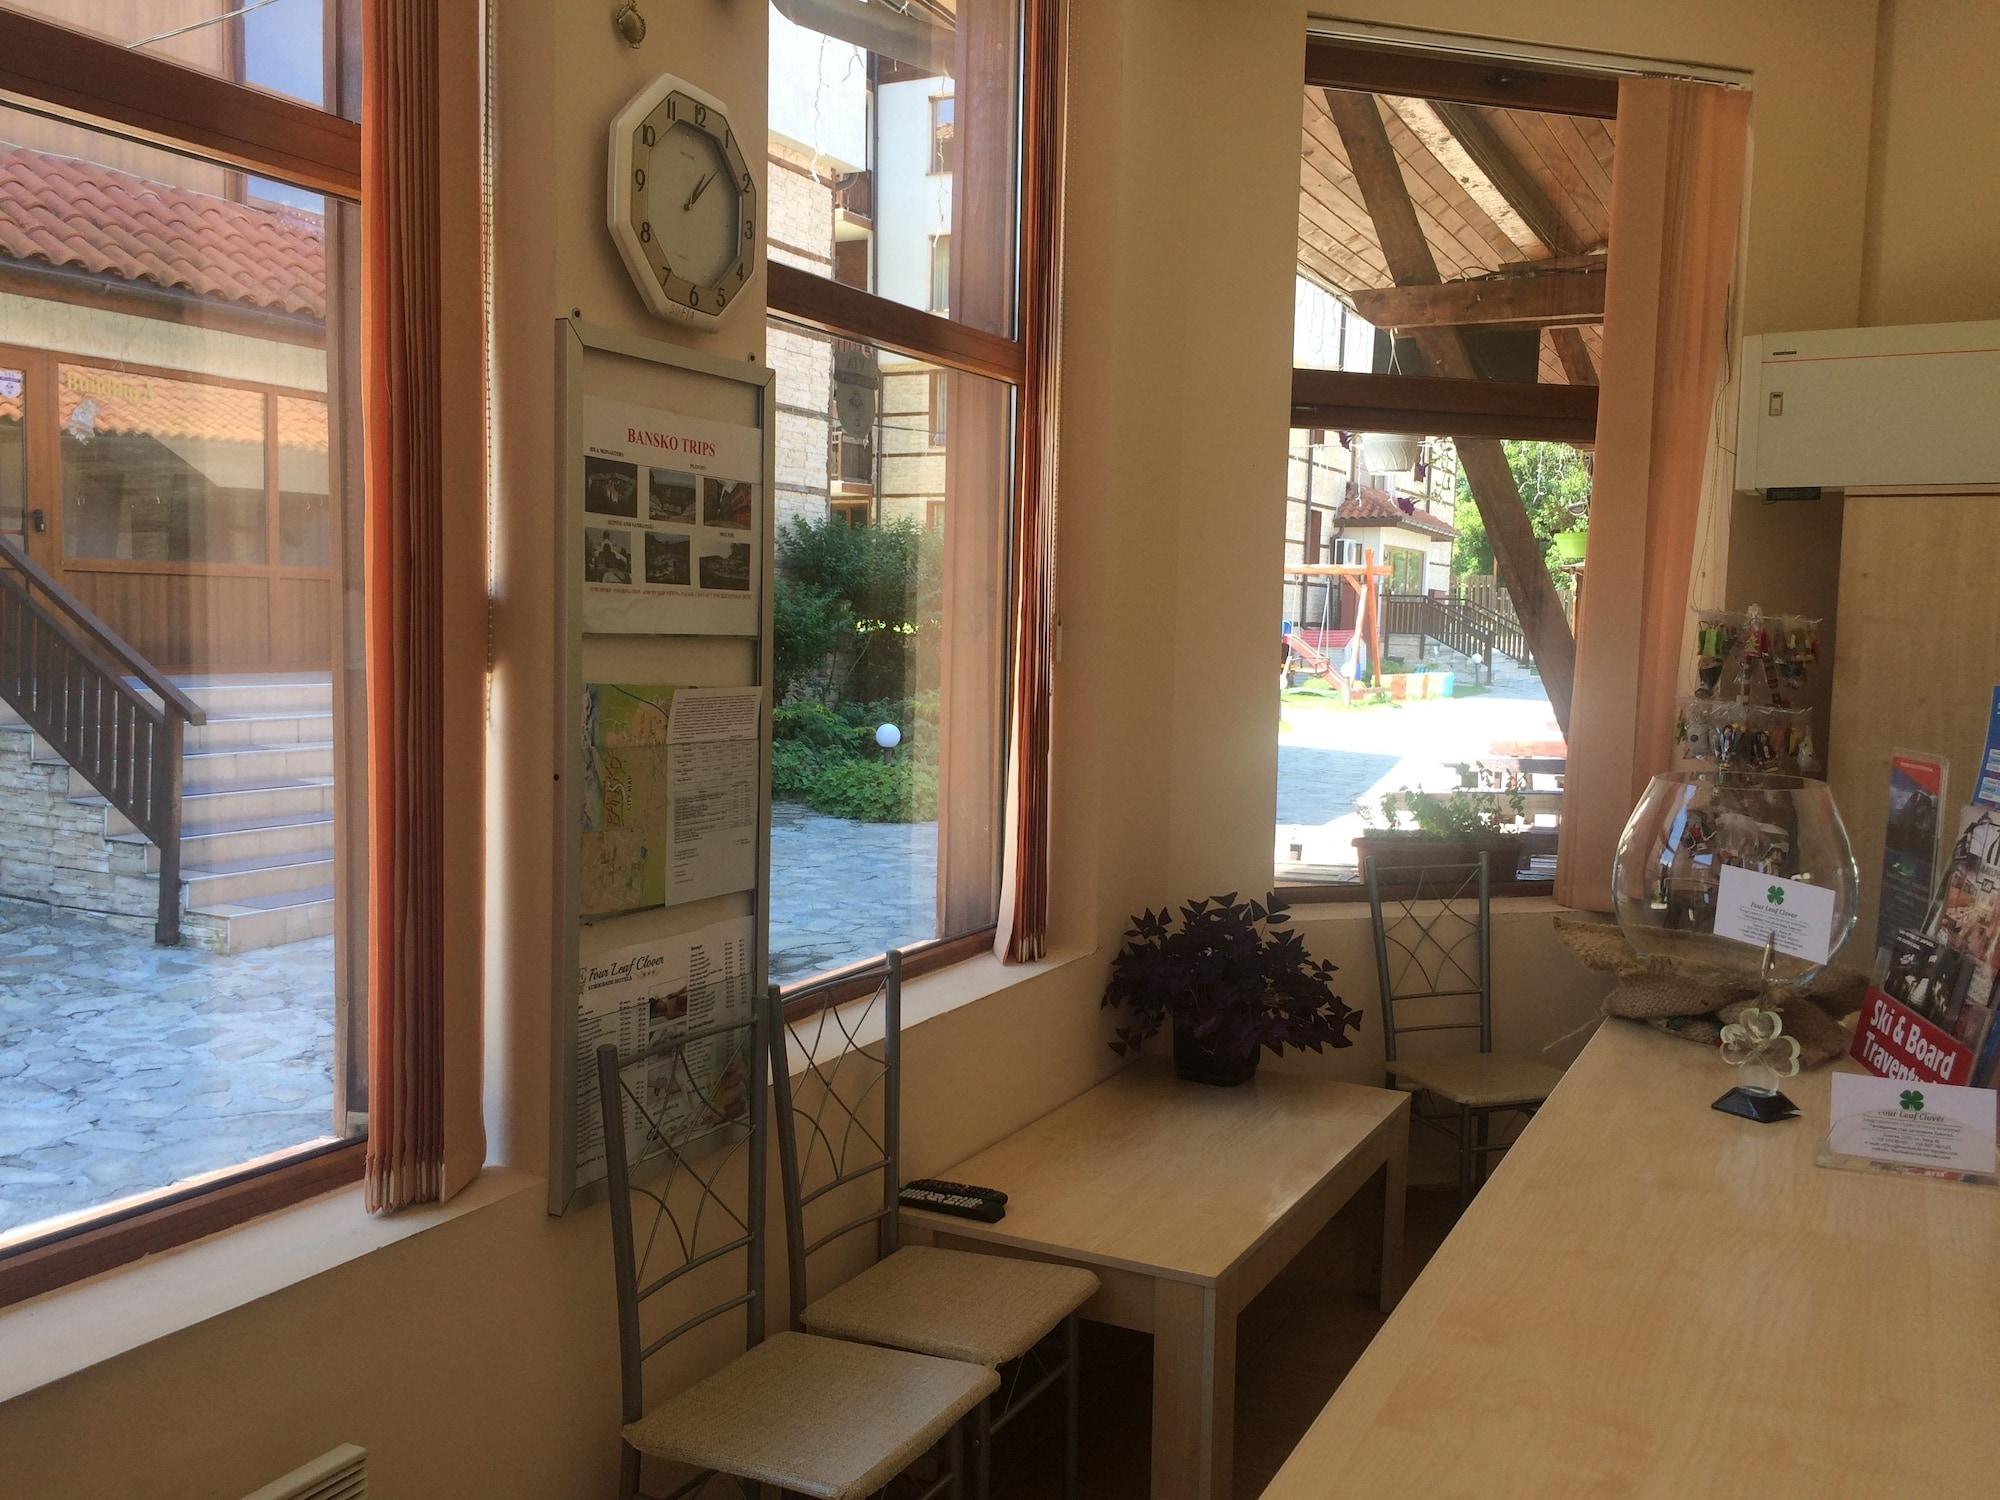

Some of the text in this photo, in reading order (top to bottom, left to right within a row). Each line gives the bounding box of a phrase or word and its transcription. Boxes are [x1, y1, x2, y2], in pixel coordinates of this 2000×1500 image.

[666, 98, 677, 121] 11
[694, 105, 707, 129] 12
[642, 124, 656, 147] 10
[725, 129, 730, 148] 1
[634, 168, 646, 192] 9
[742, 173, 751, 193] 2
[640, 222, 651, 243] 8
[744, 220, 753, 240] 3
[662, 267, 673, 287] 7
[735, 263, 745, 281] 4
[689, 285, 699, 306] 6
[716, 287, 726, 307] 5
[627, 428, 716, 457] BANSKO TRIPS
[589, 955, 664, 981] Four Leaf Clover
[1870, 999, 1957, 1081] Ski & Board
[1899, 1111, 1919, 1121] Leaf
[1919, 1113, 1945, 1123] Clover
